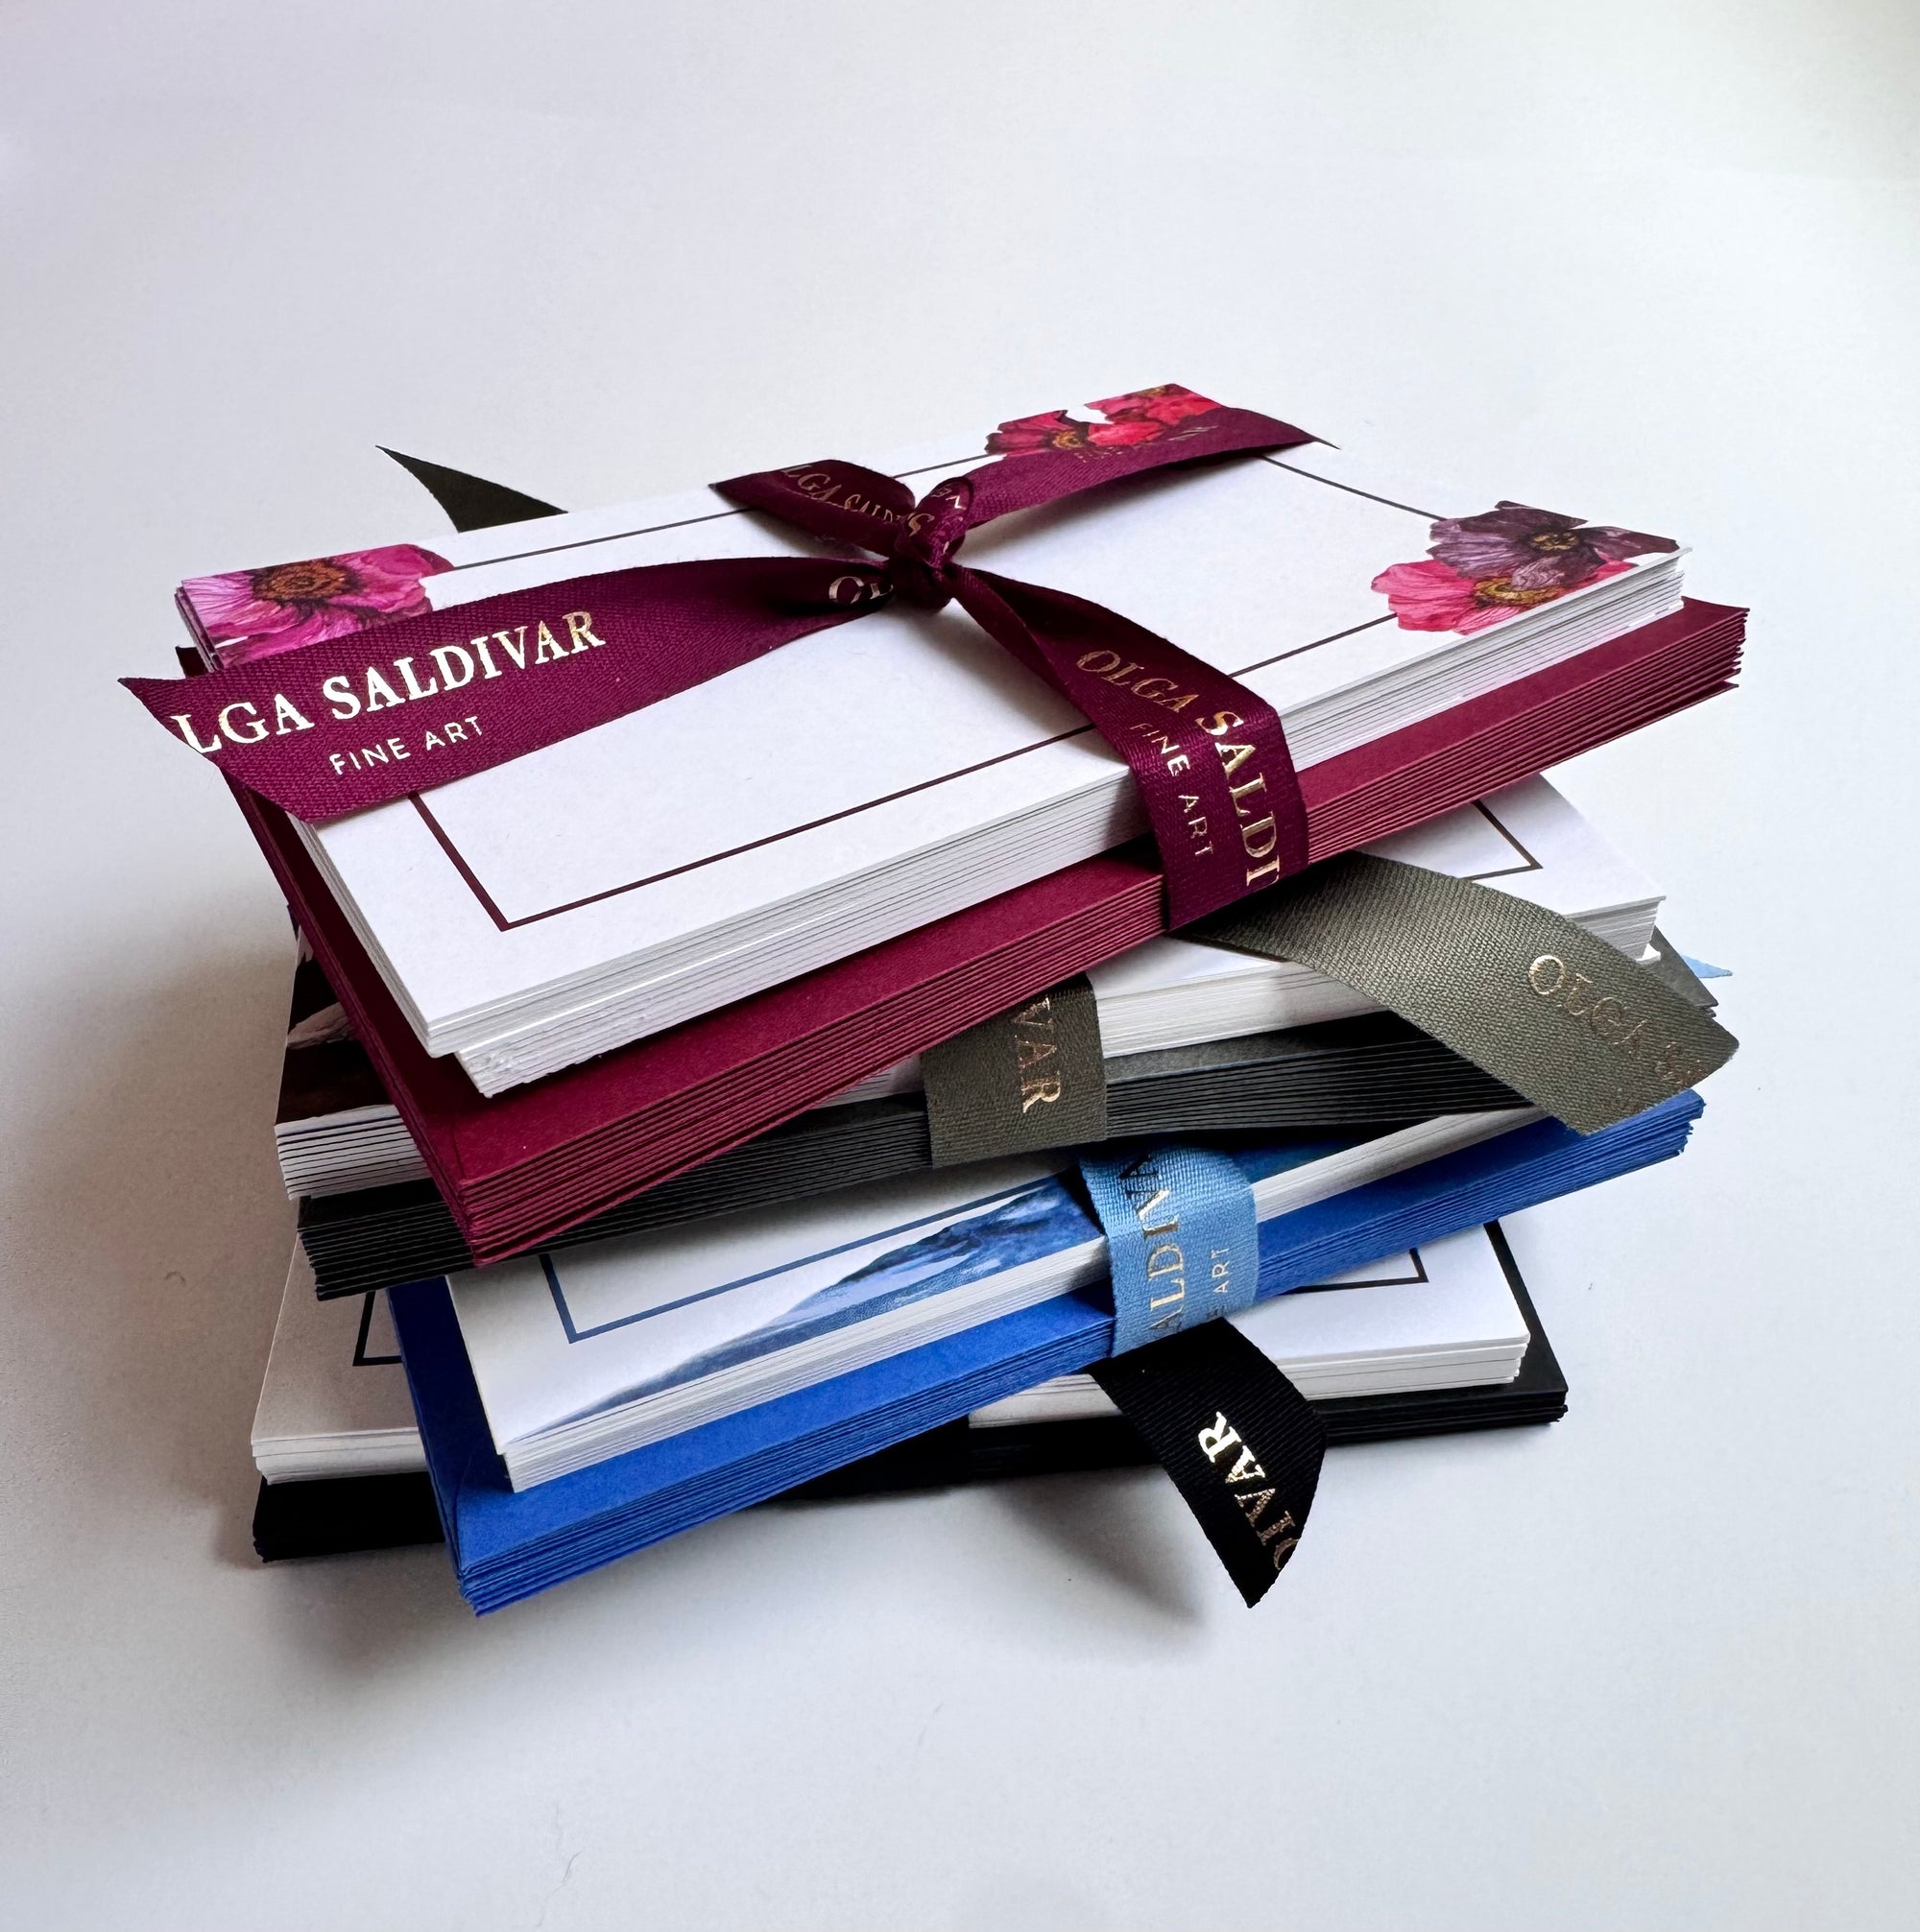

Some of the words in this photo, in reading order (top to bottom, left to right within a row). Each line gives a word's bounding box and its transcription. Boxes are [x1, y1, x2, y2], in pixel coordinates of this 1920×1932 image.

[321, 610, 606, 721] SALDIVAR
[329, 736, 411, 775] FINE
[424, 715, 484, 751] ART
[1075, 650, 1200, 713] OLGA
[1195, 710, 1281, 887] SALDI
[1129, 723, 1190, 776] FINE
[1178, 795, 1214, 855] ART
[1529, 955, 1648, 1059] OLGA
[1211, 1248, 1230, 1294] ART
